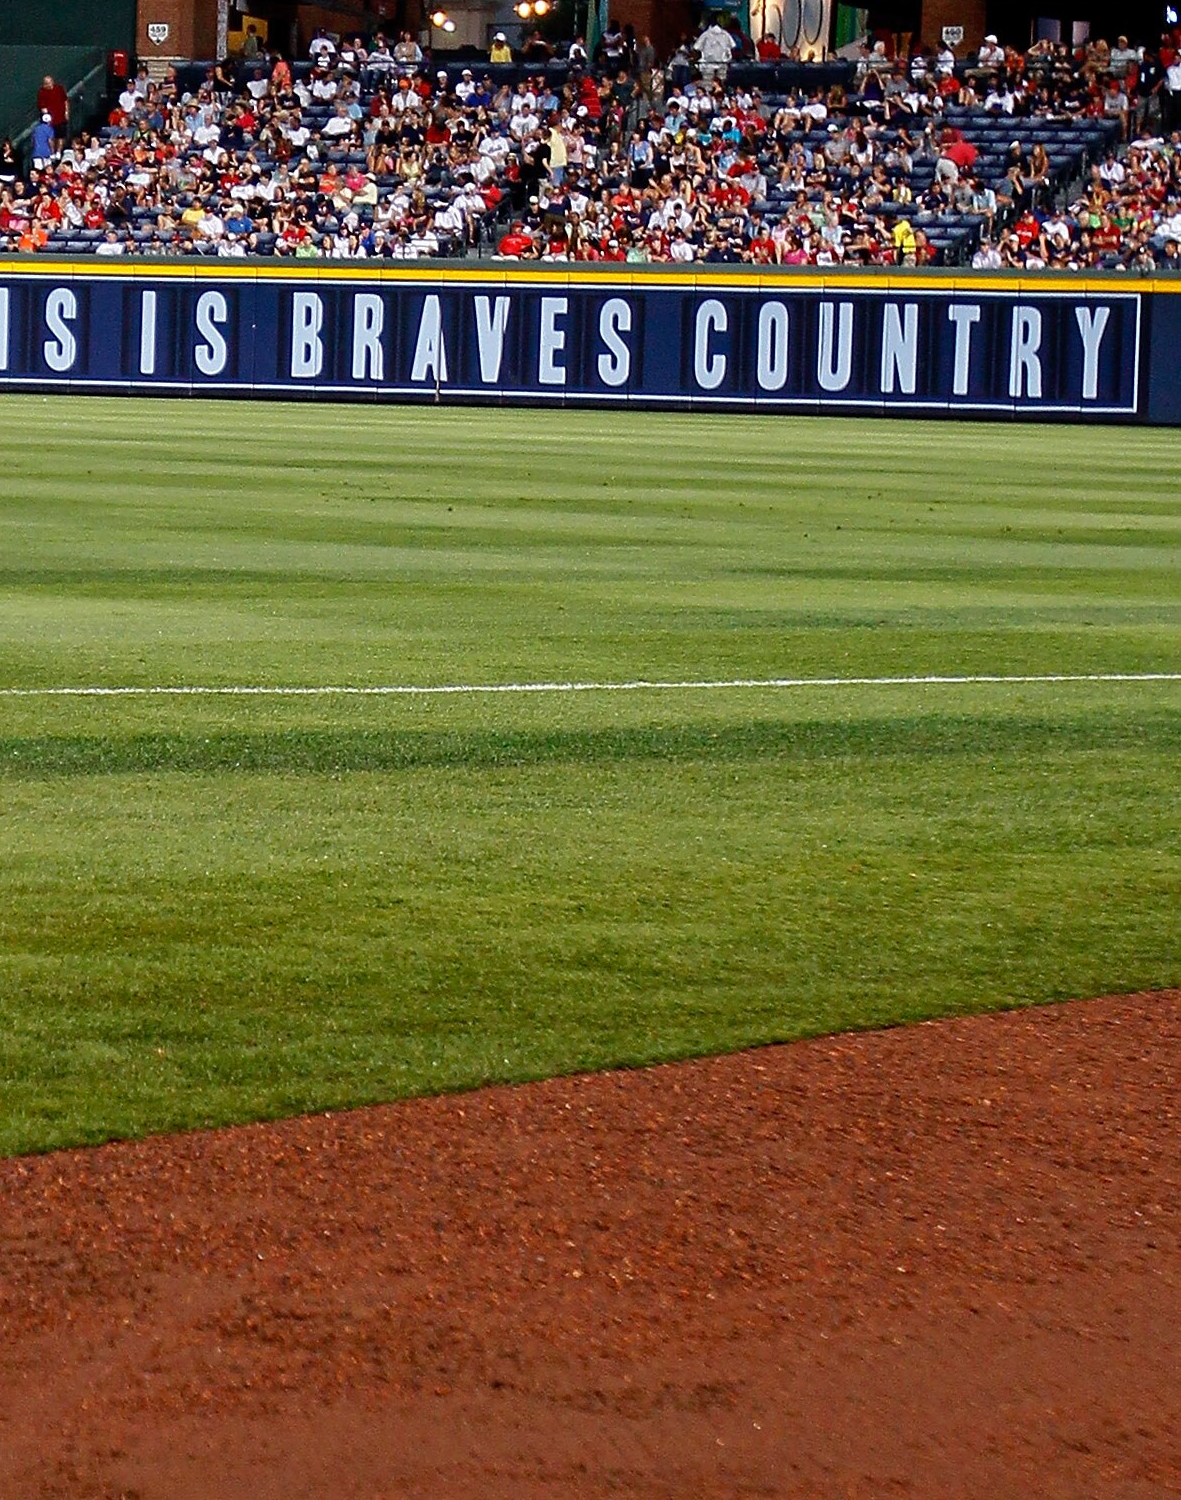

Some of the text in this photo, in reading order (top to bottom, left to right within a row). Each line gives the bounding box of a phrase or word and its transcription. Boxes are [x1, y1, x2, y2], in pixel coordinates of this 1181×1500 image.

[141, 289, 228, 377] IS
[290, 291, 632, 388] BRAVES
[693, 299, 1111, 400] COUNTRY
